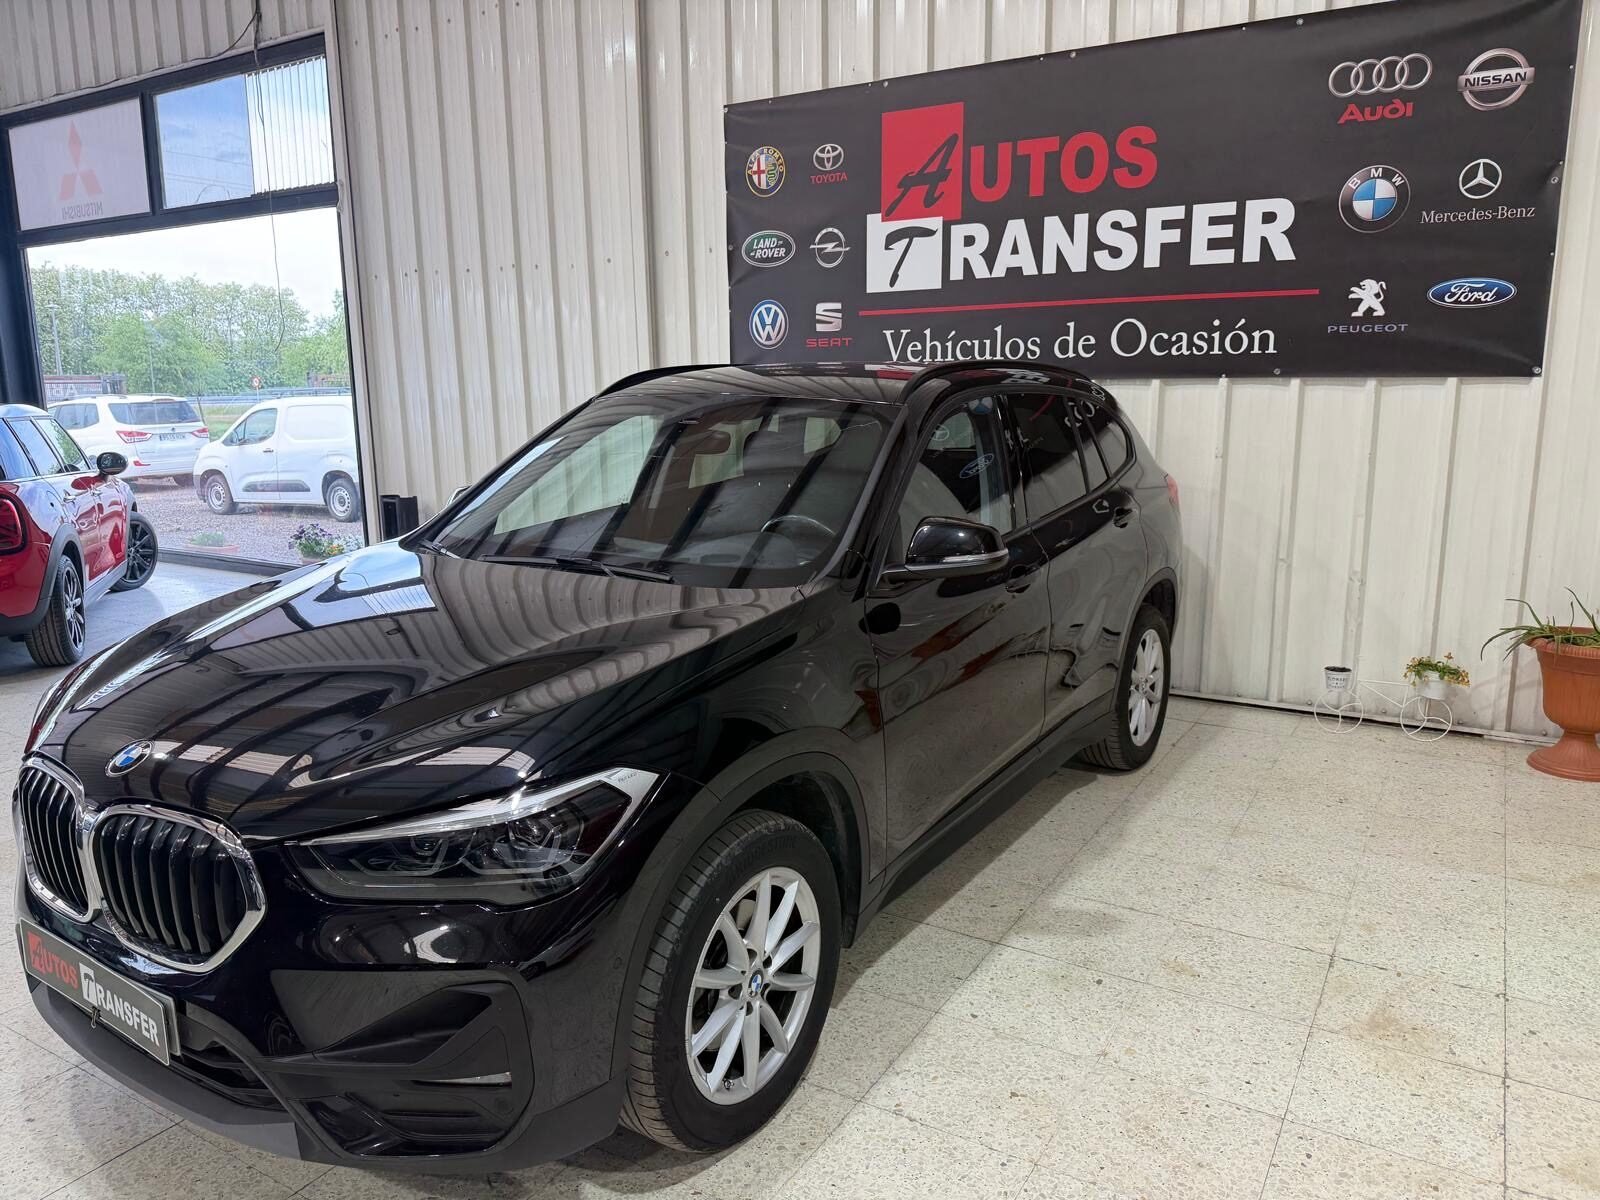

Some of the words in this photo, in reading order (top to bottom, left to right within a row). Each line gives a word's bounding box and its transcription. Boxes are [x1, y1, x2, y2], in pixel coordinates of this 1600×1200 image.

[1463, 70, 1528, 88] NISSAN
[1337, 98, 1414, 124] Audi
[810, 172, 848, 185] TOYOTA
[884, 125, 1159, 218] AUTOS
[1348, 167, 1405, 190] BMW
[1420, 205, 1536, 225] Mercedes-Benz
[884, 197, 1297, 288] TRANSFER
[1444, 282, 1499, 303] Ford
[1327, 323, 1408, 334] PEUGEOT
[806, 337, 853, 349] SEAT
[882, 325, 1041, 363] Vehículos
[1053, 321, 1097, 359] de
[1109, 317, 1278, 357] Ocasión
[29, 936, 78, 990] AUTOS
[81, 967, 160, 1047] TRANSFER
